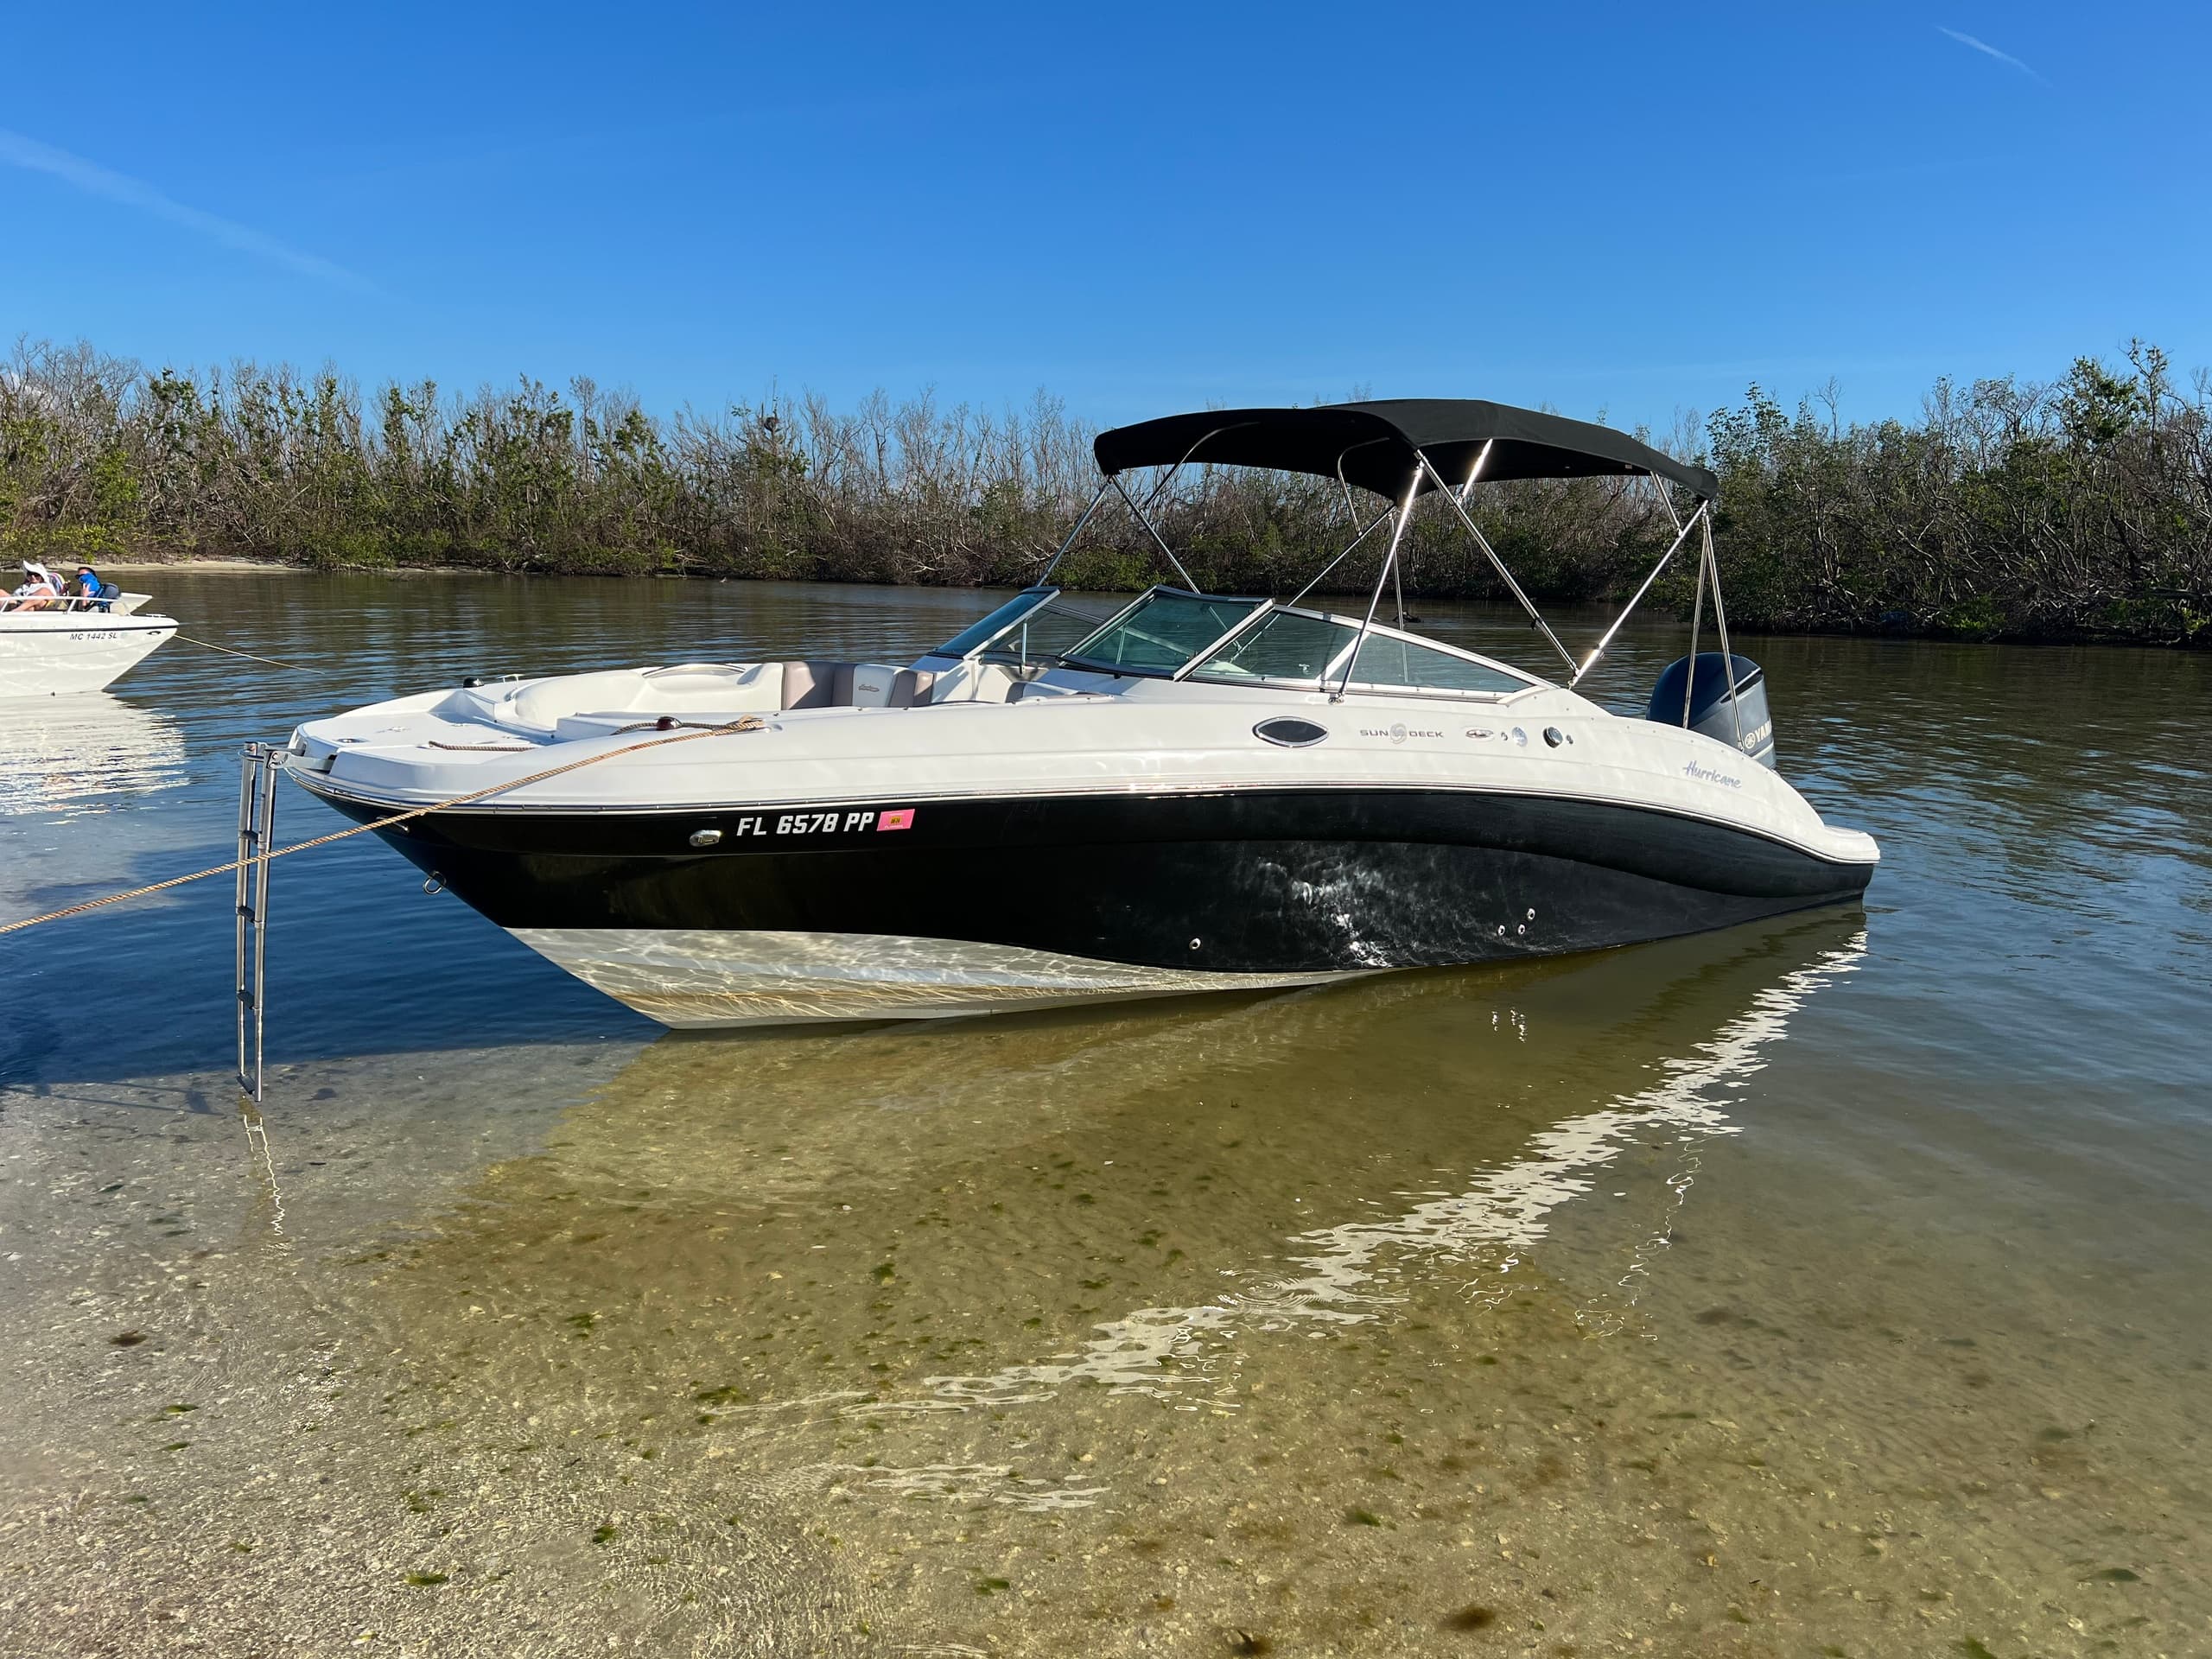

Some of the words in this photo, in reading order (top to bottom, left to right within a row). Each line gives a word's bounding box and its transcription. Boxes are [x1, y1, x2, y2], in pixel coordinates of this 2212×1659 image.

[1682, 760, 1742, 788] Hurricane
[736, 817, 767, 836] FL
[776, 813, 839, 834] 6578
[843, 811, 874, 832] PP
